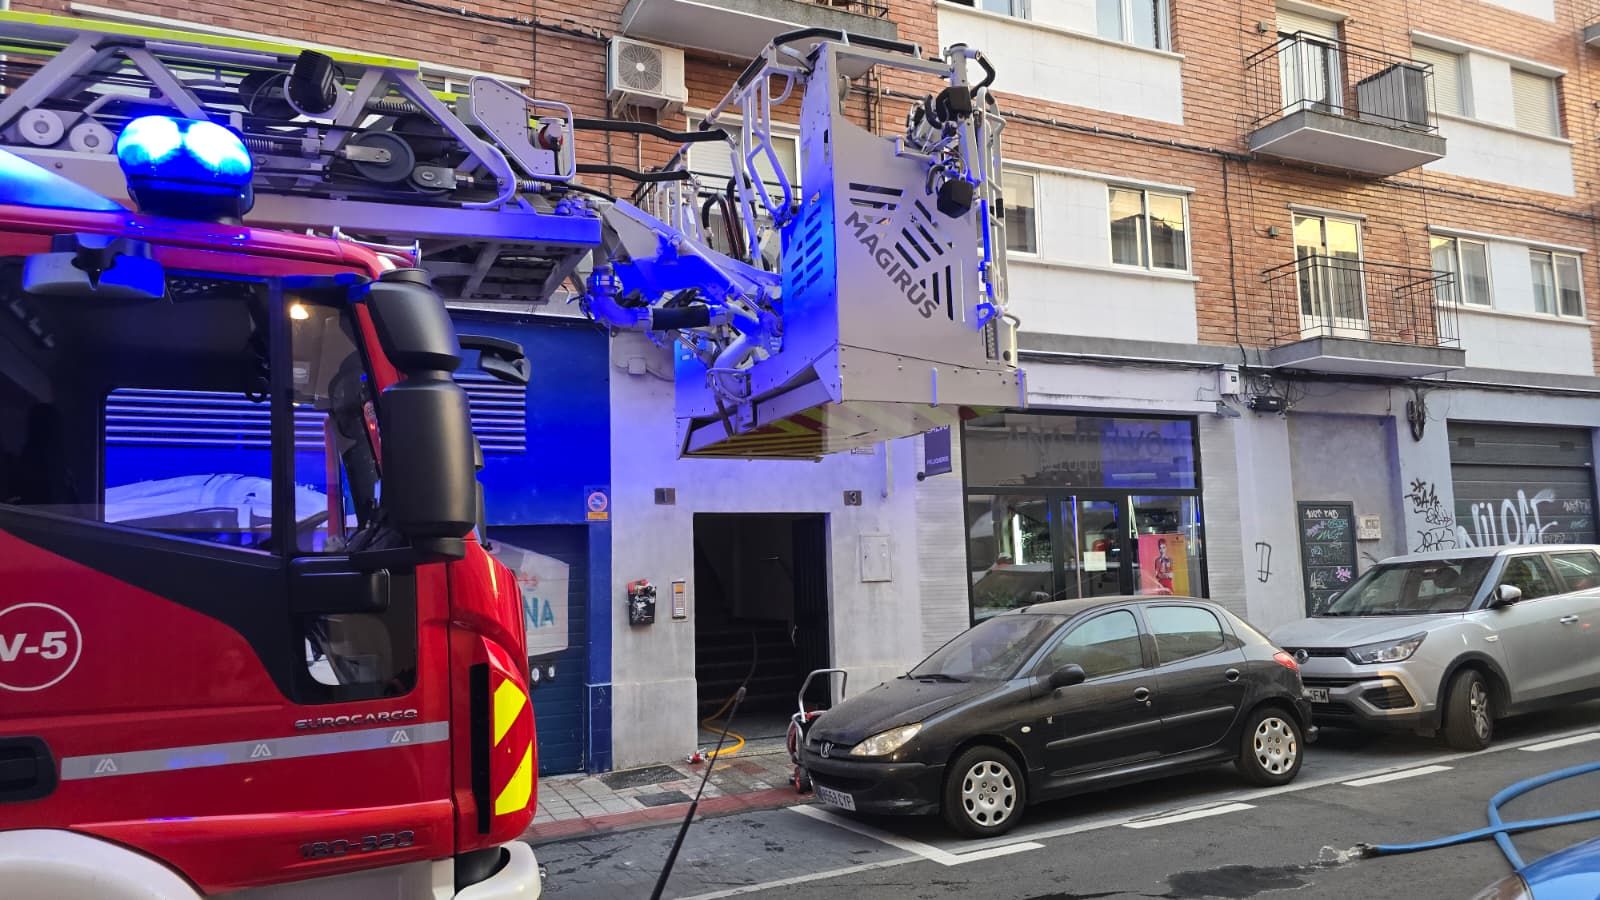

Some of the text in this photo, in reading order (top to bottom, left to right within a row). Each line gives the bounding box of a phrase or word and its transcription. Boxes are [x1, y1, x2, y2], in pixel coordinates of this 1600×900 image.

[844, 210, 938, 319] MAGIRUS
[850, 491, 857, 504] 3
[0, 631, 68, 662] V-5
[295, 708, 418, 729] EUROCARGO
